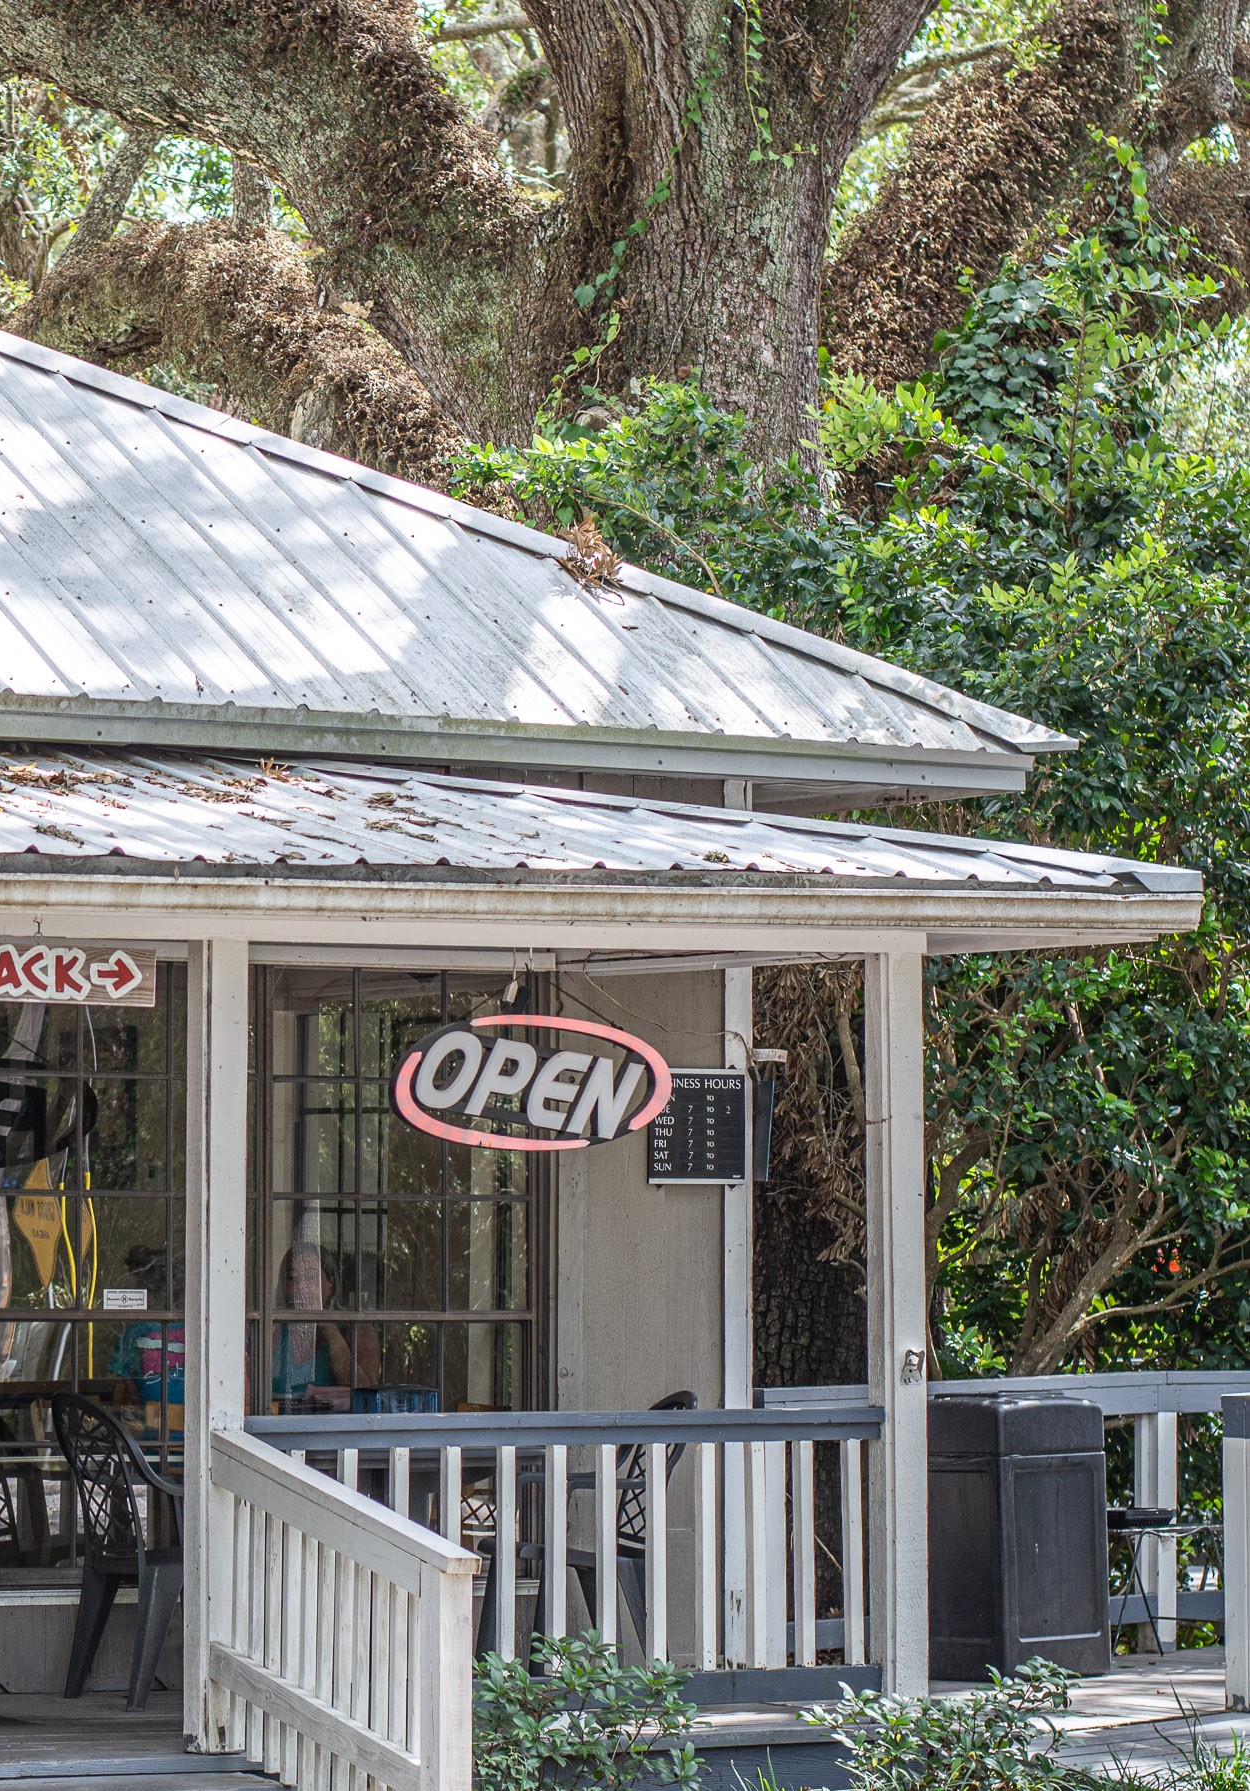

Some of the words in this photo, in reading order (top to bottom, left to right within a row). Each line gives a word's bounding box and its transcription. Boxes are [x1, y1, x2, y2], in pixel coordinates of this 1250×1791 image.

[414, 1030, 647, 1140] OPEN
[673, 1078, 701, 1088] INESS
[704, 1078, 741, 1089] HOURS
[688, 1105, 693, 1113] 7
[726, 1106, 731, 1114] 2
[655, 1116, 675, 1125] WED
[688, 1117, 694, 1125] 7
[655, 1128, 673, 1136] THU
[654, 1140, 667, 1148] FRI
[688, 1140, 694, 1148] 7
[654, 1151, 669, 1160] SAT
[689, 1152, 695, 1160] 7
[654, 1163, 672, 1171] SUN
[688, 1163, 693, 1171] 7
